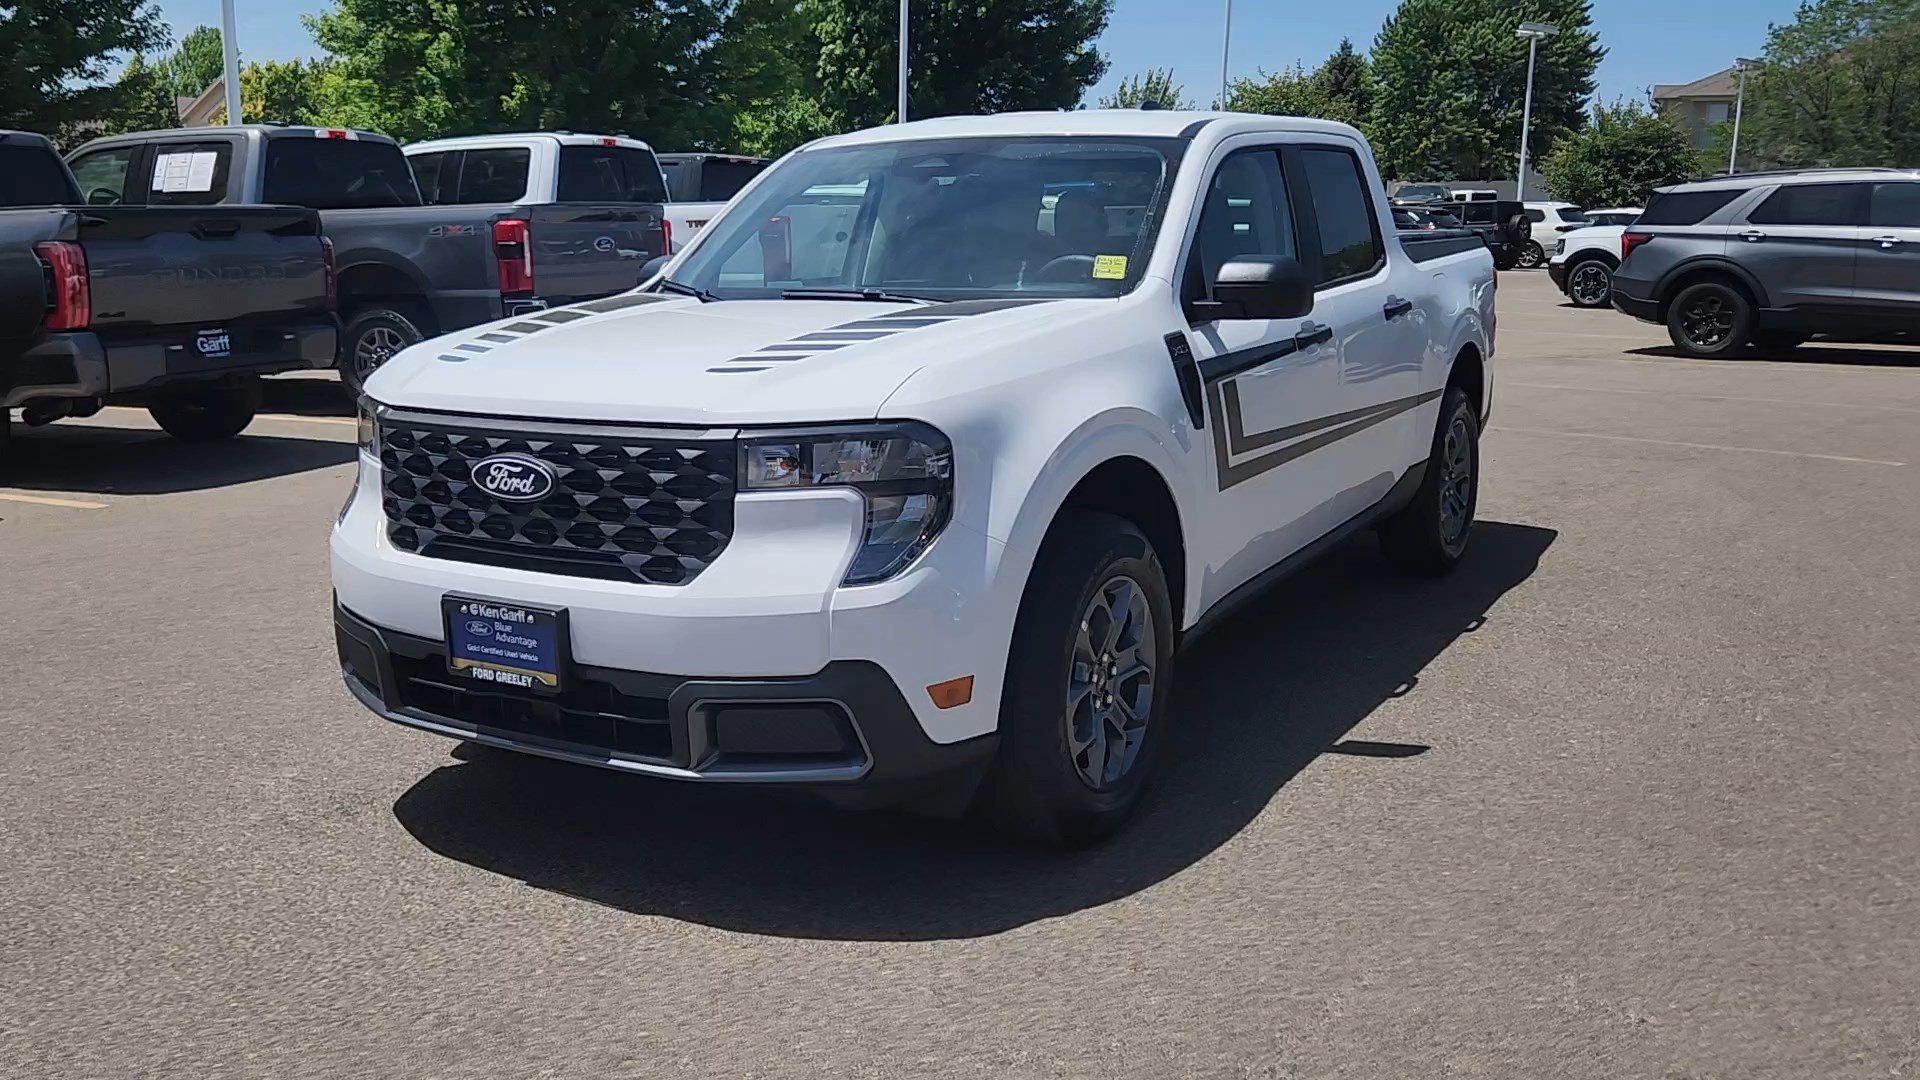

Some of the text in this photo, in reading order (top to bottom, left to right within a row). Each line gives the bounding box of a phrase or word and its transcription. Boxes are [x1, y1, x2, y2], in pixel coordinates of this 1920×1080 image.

[196, 334, 230, 352] Garff
[486, 463, 536, 494] Ford
[494, 621, 512, 633] Blue
[495, 632, 538, 649] Advantage
[467, 644, 539, 662] Gold Certified Used Vehicle
[472, 667, 533, 688] FORD GREELEY
